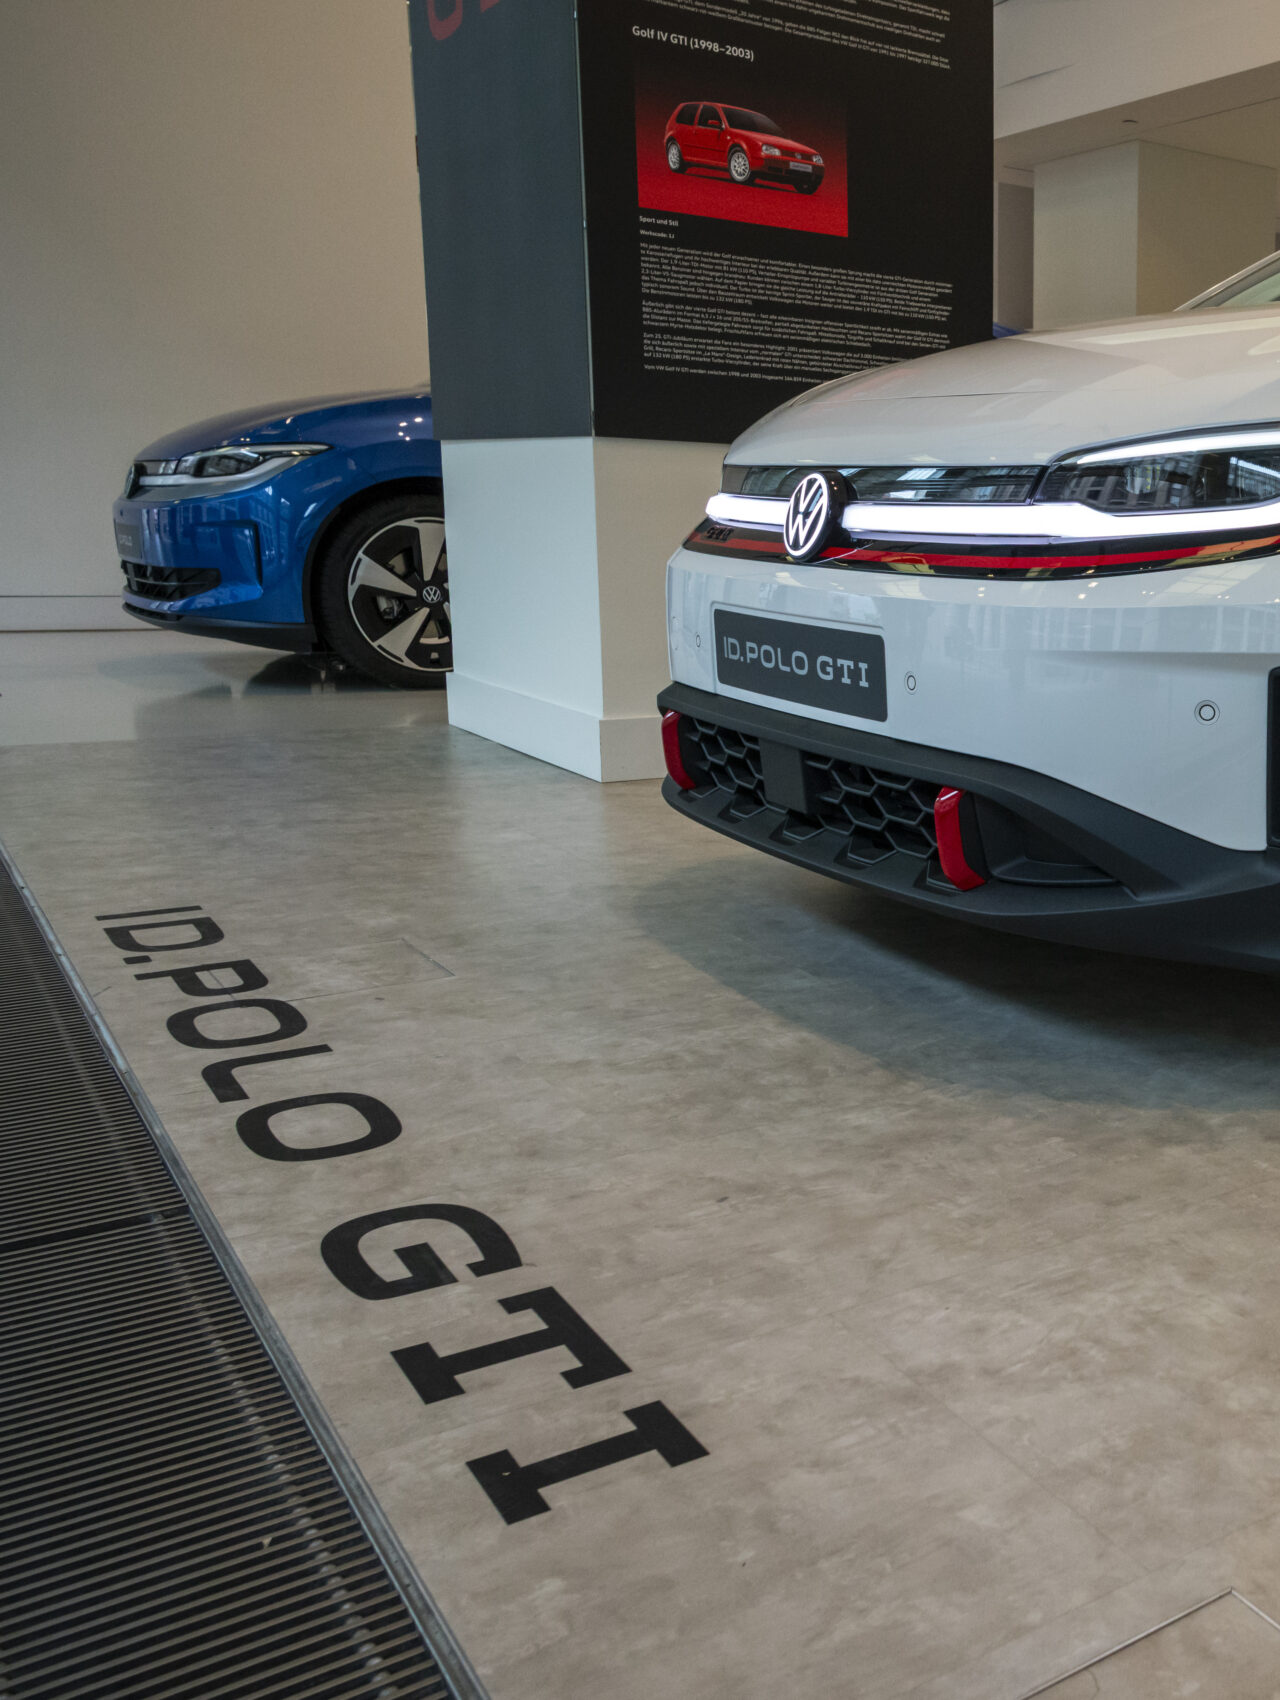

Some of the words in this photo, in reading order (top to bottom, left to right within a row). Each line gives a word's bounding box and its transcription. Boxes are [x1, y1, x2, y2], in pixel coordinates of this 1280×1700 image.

[632, 25, 655, 39] Golf
[657, 31, 668, 42] IV
[670, 33, 688, 46] GTI
[639, 215, 656, 225] Sport
[668, 219, 679, 227] Stil
[723, 636, 808, 676] ID.POLO
[816, 655, 869, 688] GTI
[95, 905, 402, 1161] ID.POLO
[320, 1203, 710, 1525] GTI
